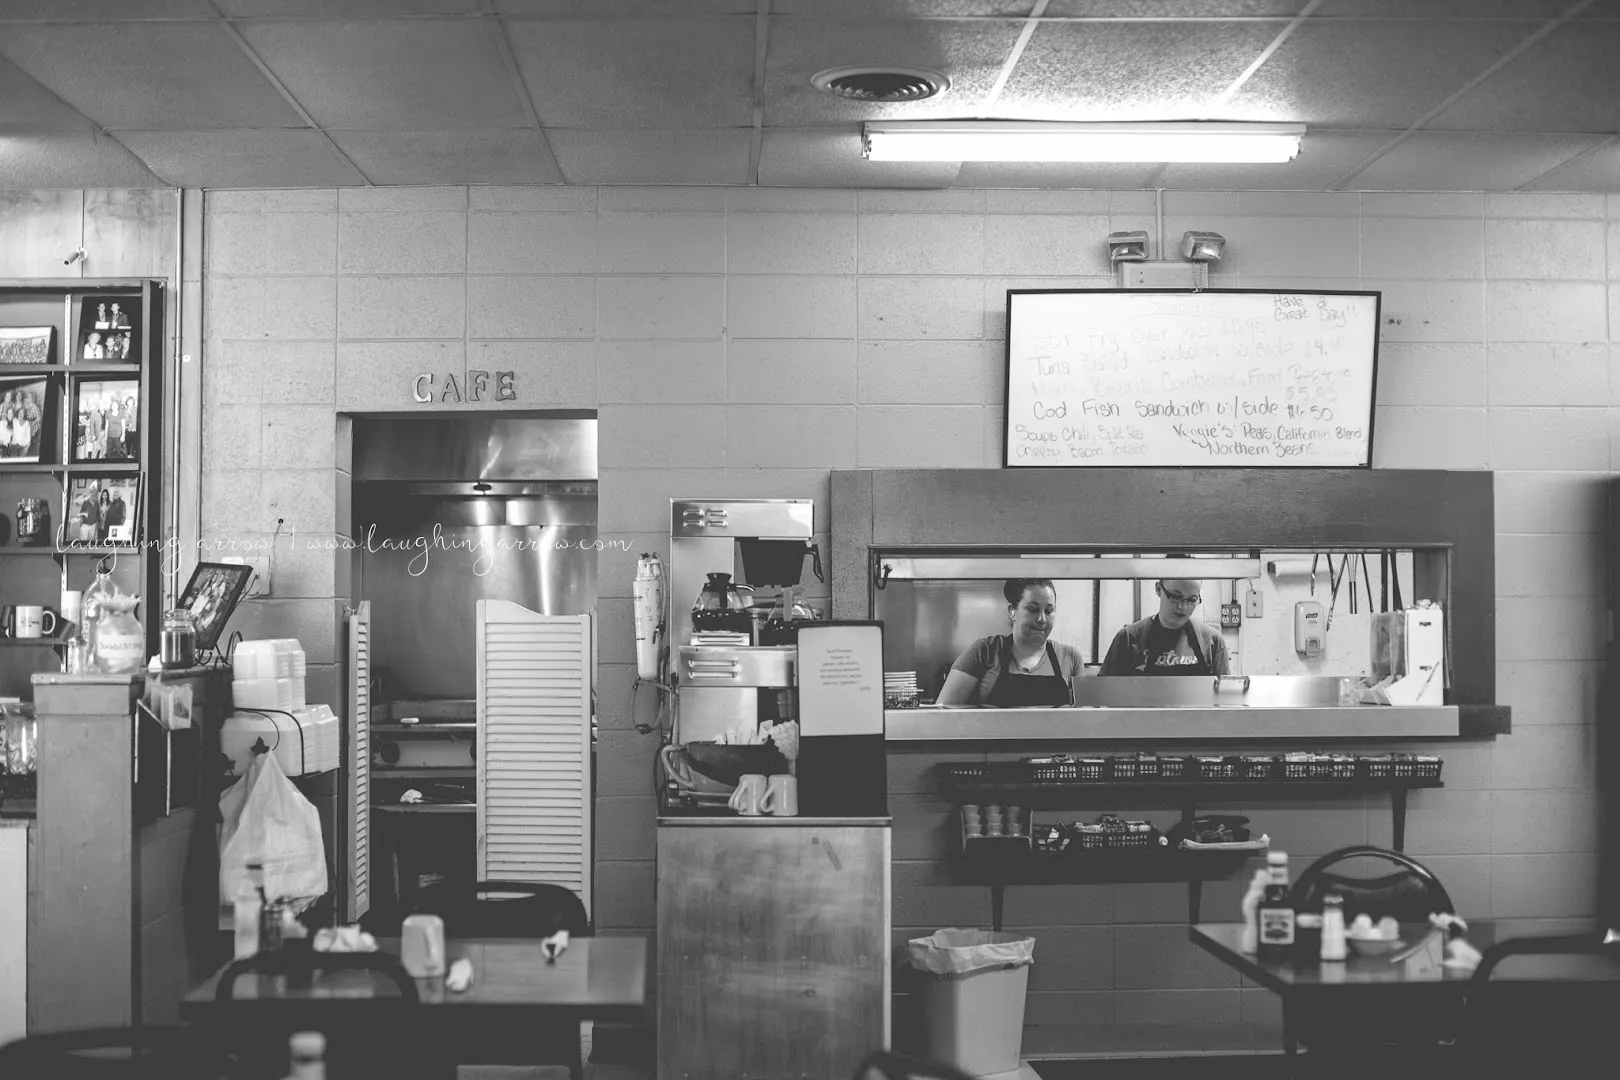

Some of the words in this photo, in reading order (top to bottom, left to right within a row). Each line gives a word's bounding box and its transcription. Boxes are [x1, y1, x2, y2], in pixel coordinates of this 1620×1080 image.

[1274, 307, 1311, 321] Great
[1088, 327, 1119, 355] Fry
[1026, 354, 1071, 376] Tuna
[411, 369, 516, 403] CAFE
[1033, 401, 1068, 421] Cod
[1082, 398, 1121, 417] Fish
[1135, 400, 1210, 418] Sandwich
[1208, 441, 1270, 456] Northern
